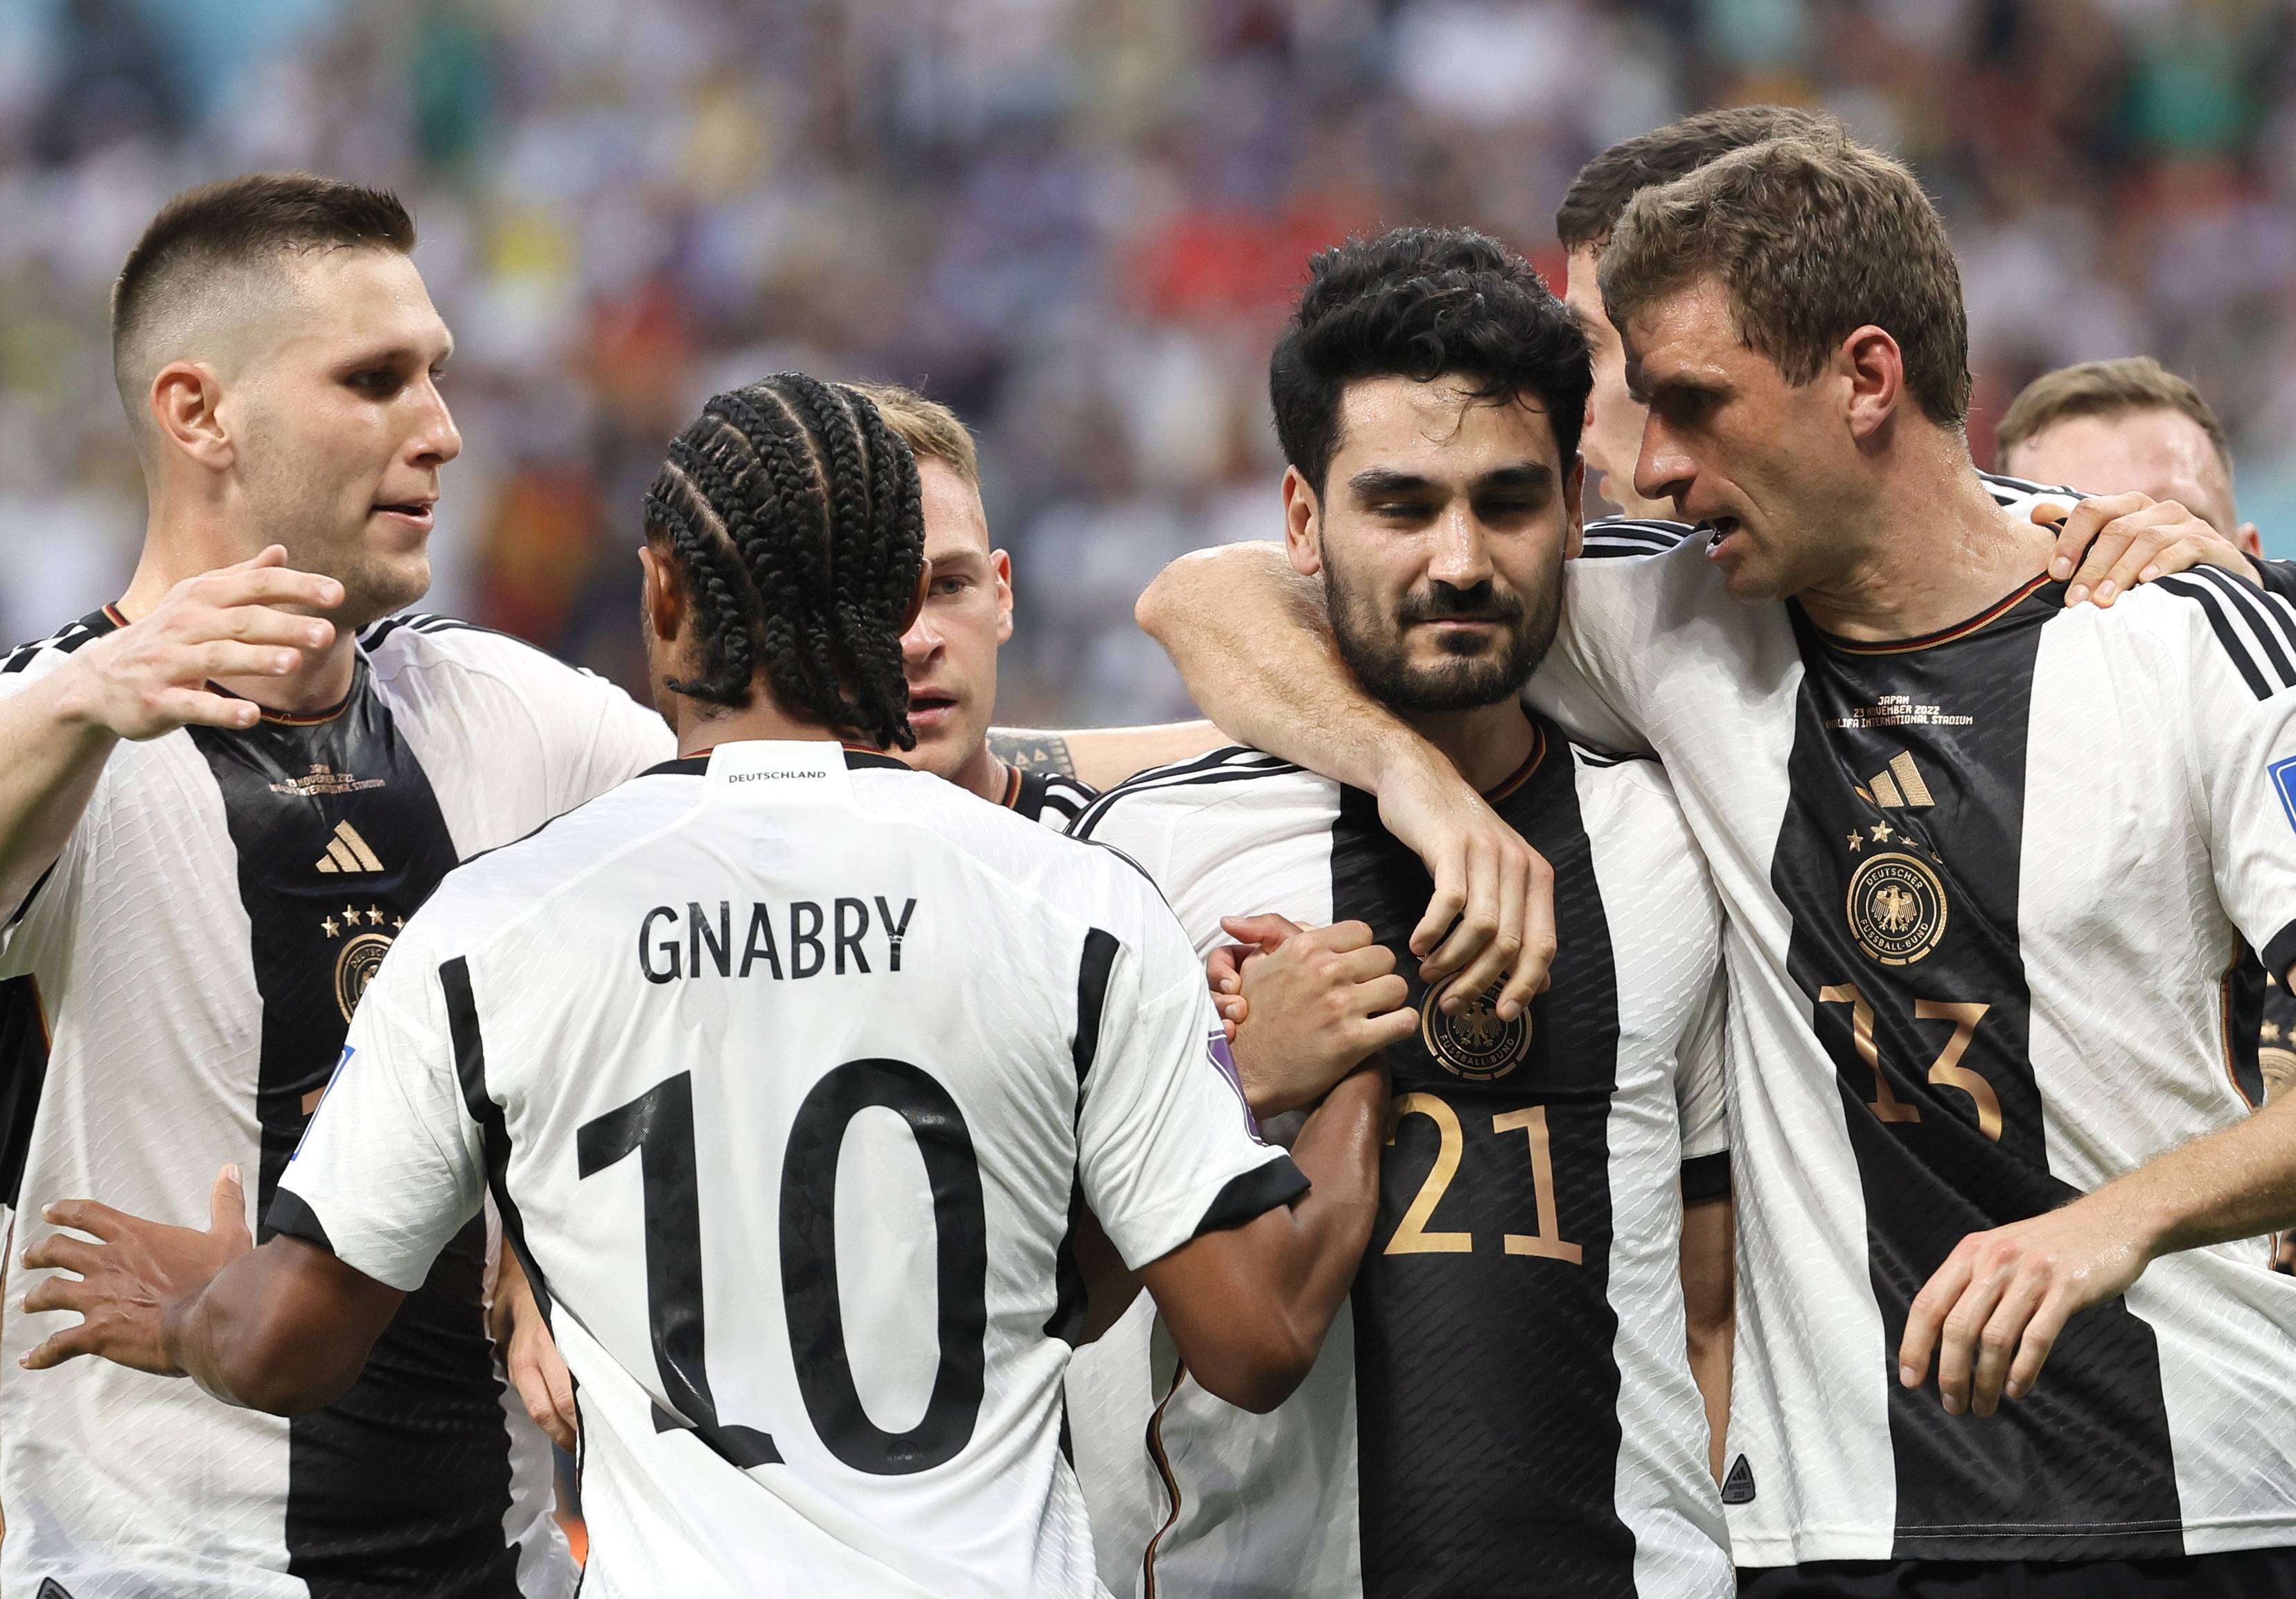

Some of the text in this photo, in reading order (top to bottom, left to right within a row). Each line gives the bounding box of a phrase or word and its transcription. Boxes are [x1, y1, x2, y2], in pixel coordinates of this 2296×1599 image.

[1853, 705, 1941, 718] 23 NOVEMBER 2022
[1878, 695, 1910, 705] JAPAN
[1861, 714, 1929, 727] INTERNATIONAL
[1931, 714, 1974, 726] STADIUM
[729, 770, 827, 784] DEUTSCHLAND
[1866, 867, 1923, 890] DEUTSCHER
[638, 895, 918, 984] GNABRY
[1860, 919, 1929, 951] FUSSBALL-BUND
[1440, 1034, 1515, 1066] FUSSBALL-BUND
[1819, 982, 2003, 1143] 13
[1383, 1092, 1583, 1265] 21
[576, 1057, 988, 1476] 10
